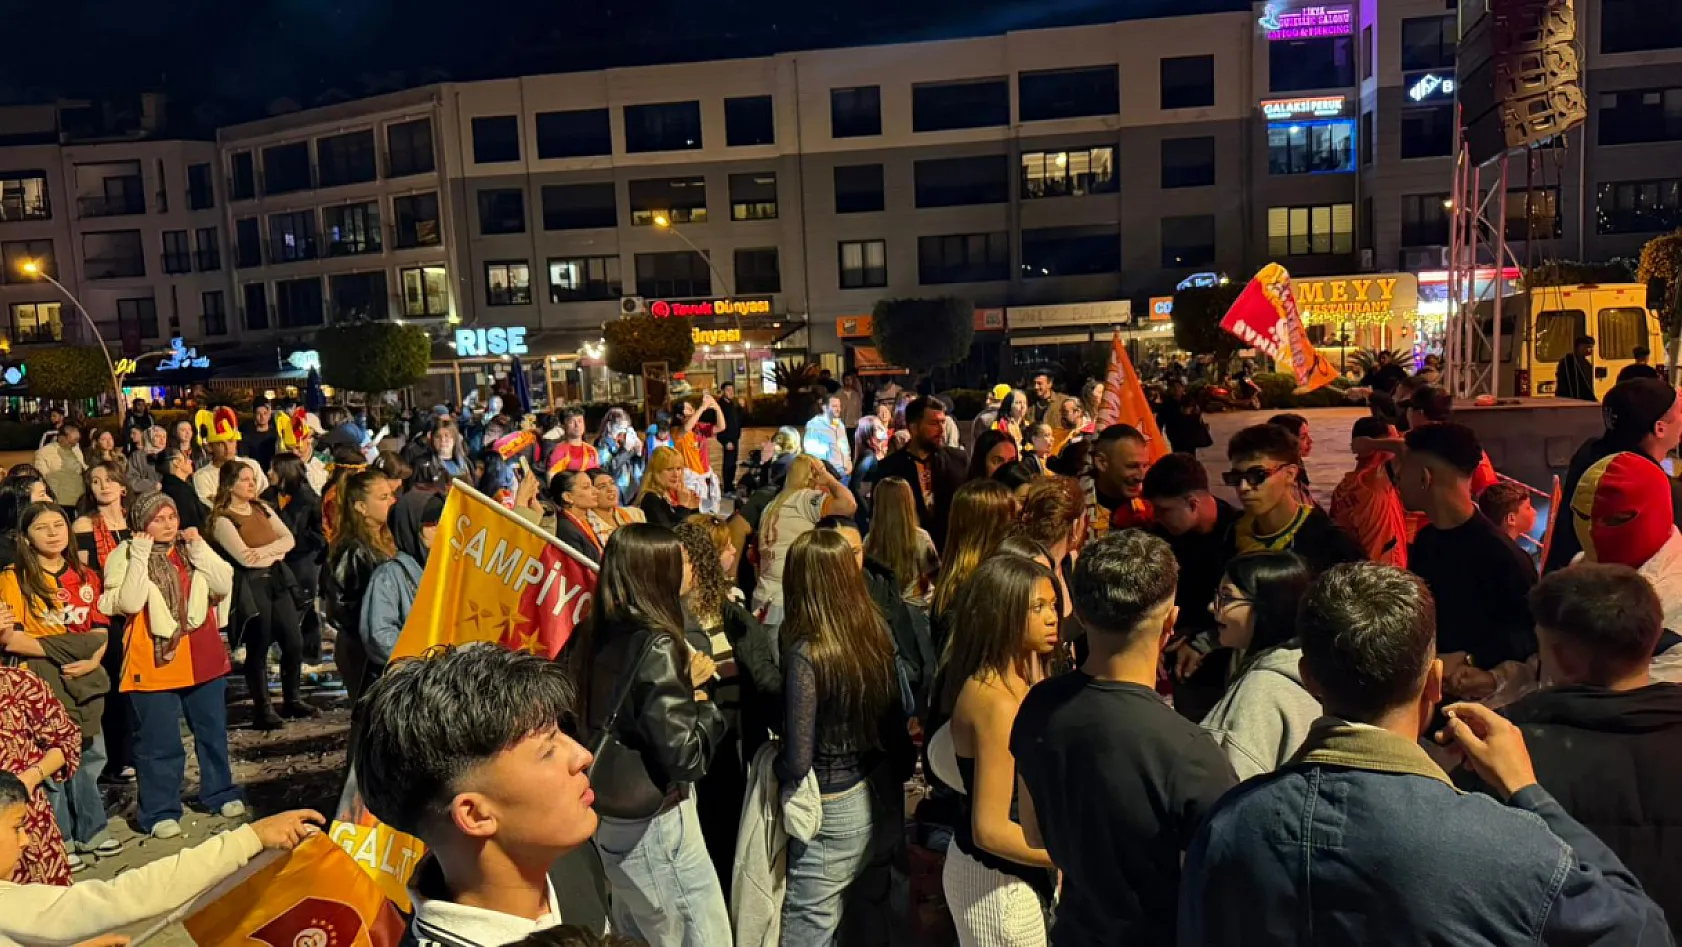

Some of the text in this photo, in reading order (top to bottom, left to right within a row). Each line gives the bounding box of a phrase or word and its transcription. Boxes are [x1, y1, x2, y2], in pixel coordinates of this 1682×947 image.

[1311, 99, 1342, 112] PERUK
[1297, 279, 1397, 303] MEYY
[714, 300, 769, 316] Dünyası
[455, 326, 529, 356] RISE
[333, 822, 417, 884] GALT
